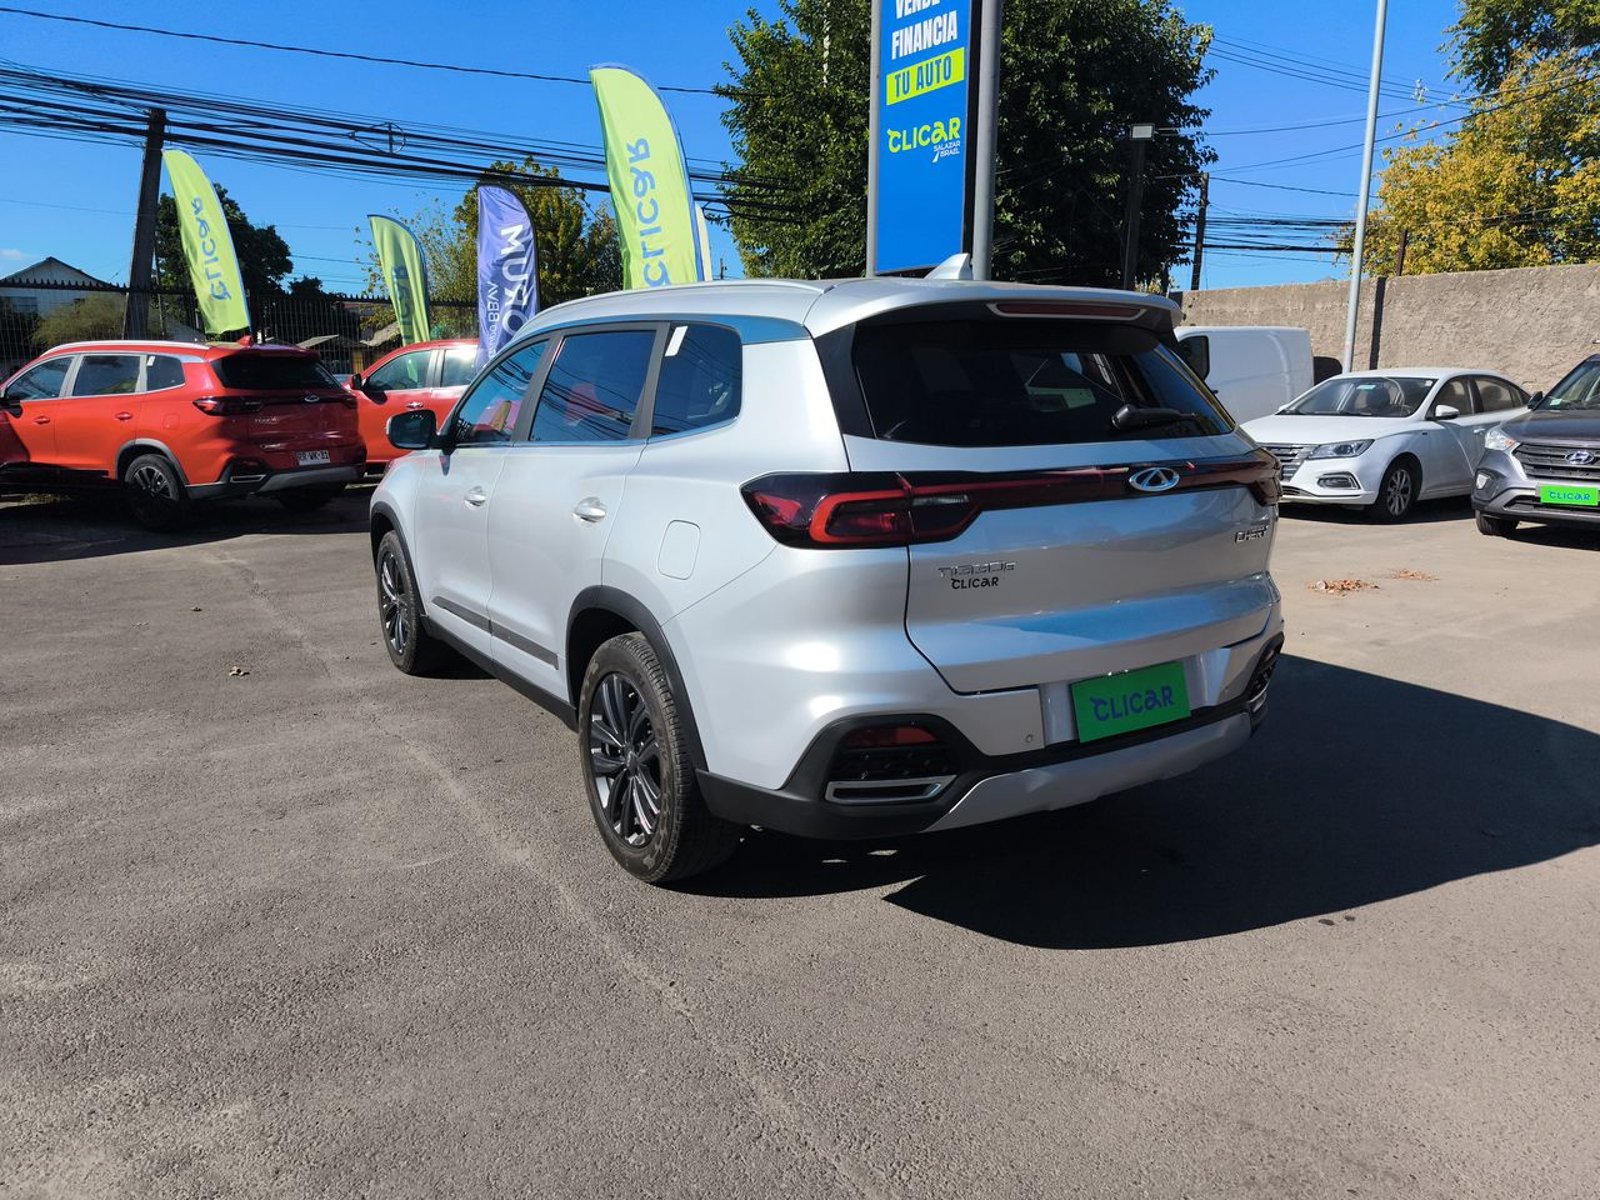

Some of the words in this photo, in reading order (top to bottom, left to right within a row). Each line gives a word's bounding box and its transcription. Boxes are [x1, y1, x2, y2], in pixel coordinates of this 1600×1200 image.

[892, 10, 958, 60] FINANCIA
[895, 70, 910, 97] TU
[916, 56, 951, 91] AUTO
